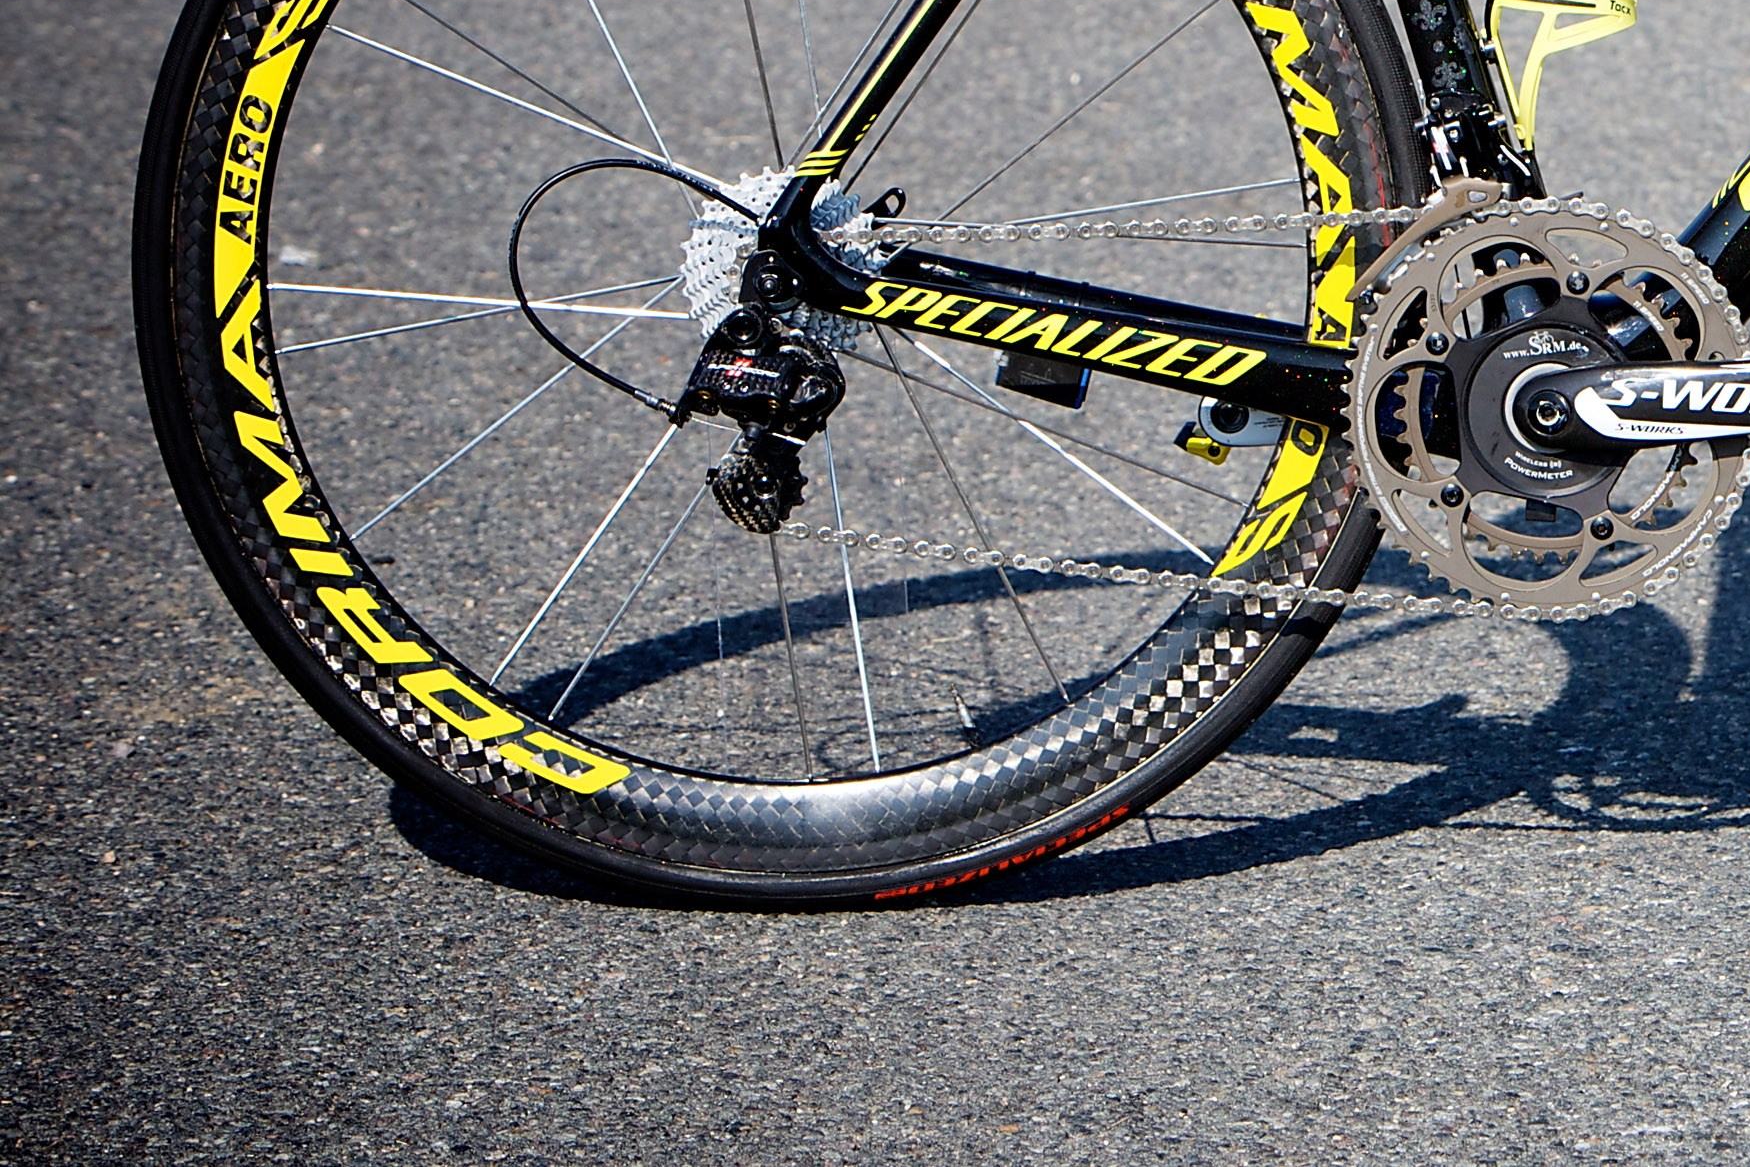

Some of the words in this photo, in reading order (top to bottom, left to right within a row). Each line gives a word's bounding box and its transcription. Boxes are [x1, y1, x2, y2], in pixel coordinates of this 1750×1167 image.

[1609, 0, 1632, 16] Tacx
[219, 94, 273, 245] AERO
[841, 281, 1267, 387] SPECIALIZED
[1614, 422, 1685, 435] S-WORKS
[220, 279, 630, 795] CORIMA
